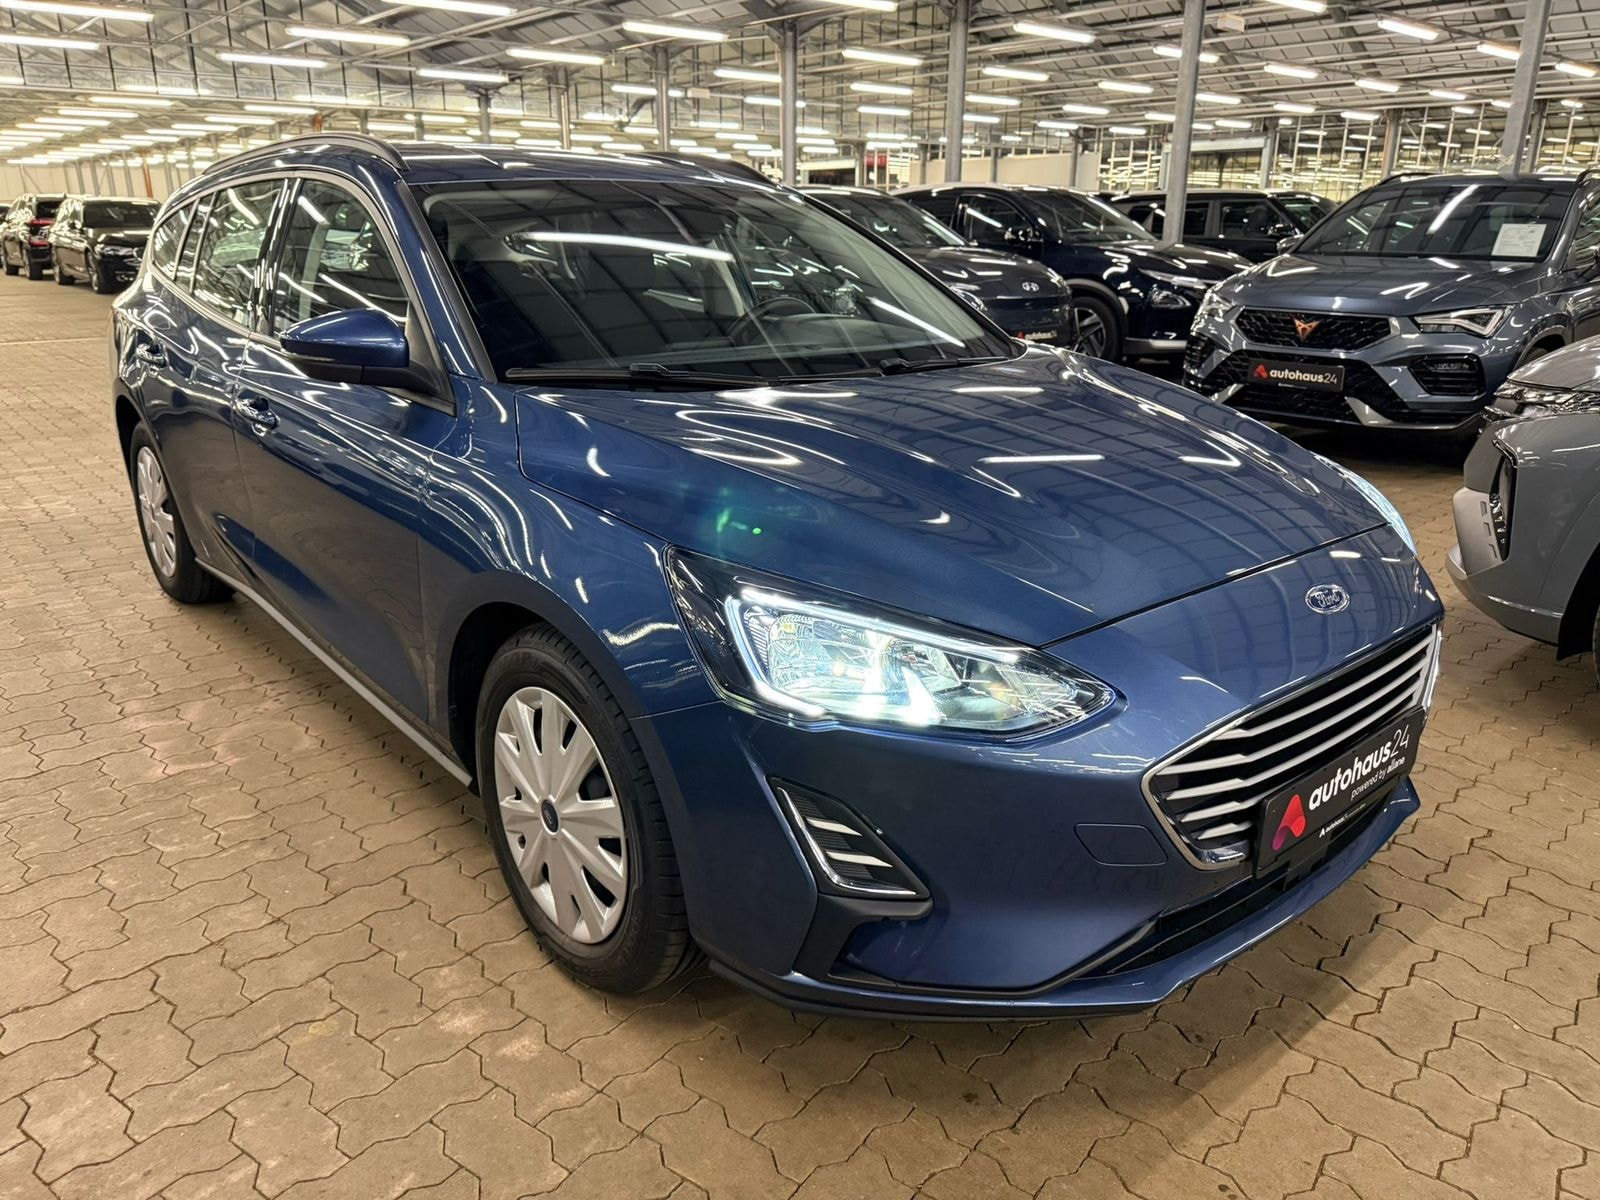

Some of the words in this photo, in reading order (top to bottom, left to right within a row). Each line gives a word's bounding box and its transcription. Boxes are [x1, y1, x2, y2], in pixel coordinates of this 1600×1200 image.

[1269, 368, 1338, 385] autohaus24
[1310, 589, 1342, 608] Ford
[1308, 724, 1411, 811] autohaus24
[1350, 770, 1379, 802] powered
